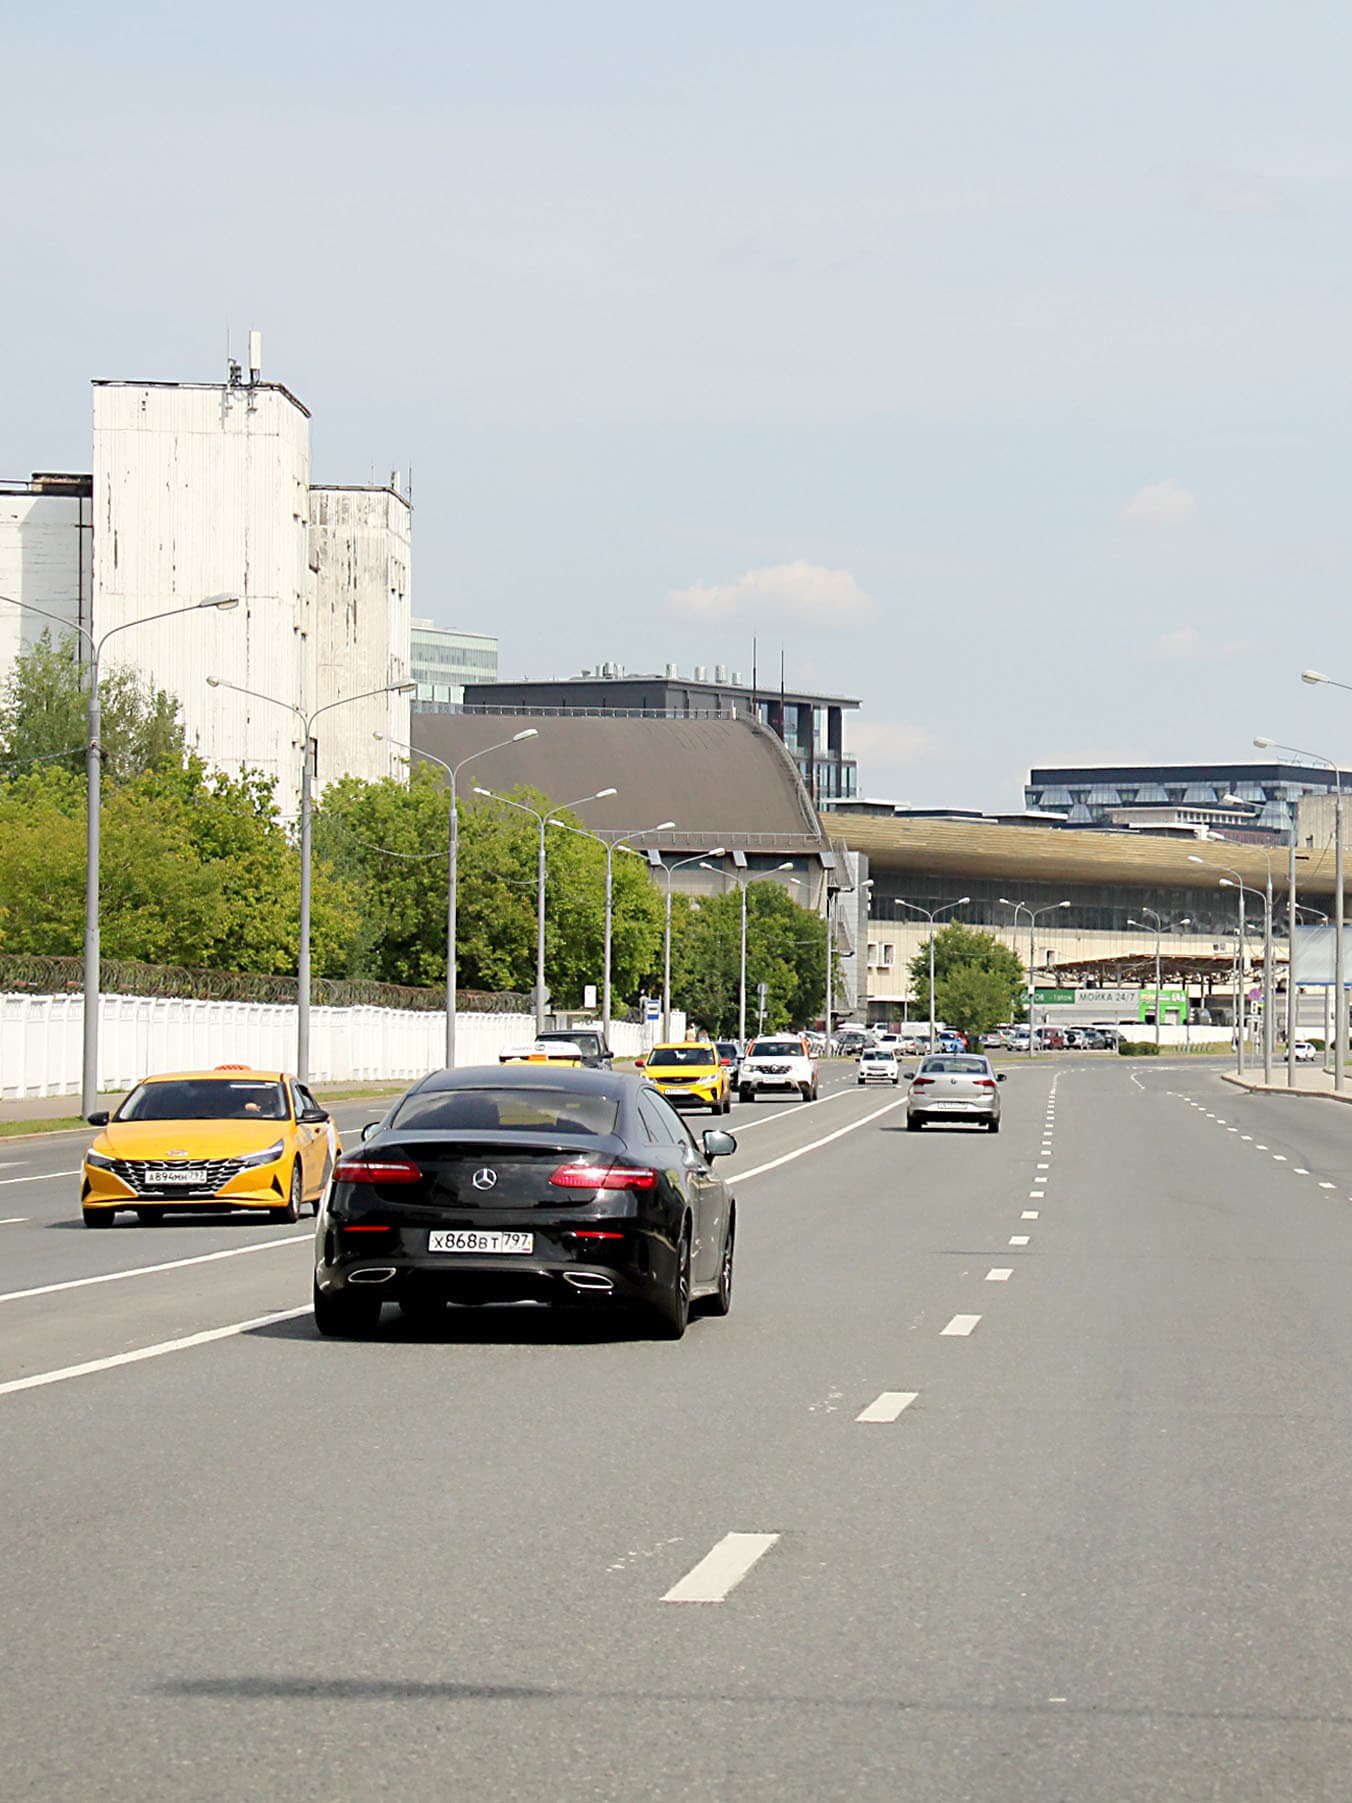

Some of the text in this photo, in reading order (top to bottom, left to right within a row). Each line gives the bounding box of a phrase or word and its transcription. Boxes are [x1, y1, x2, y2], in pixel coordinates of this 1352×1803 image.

[1078, 990, 1113, 1002] МОЙКА
[1115, 992, 1136, 1001] 24/7
[503, 1233, 529, 1246] 797
